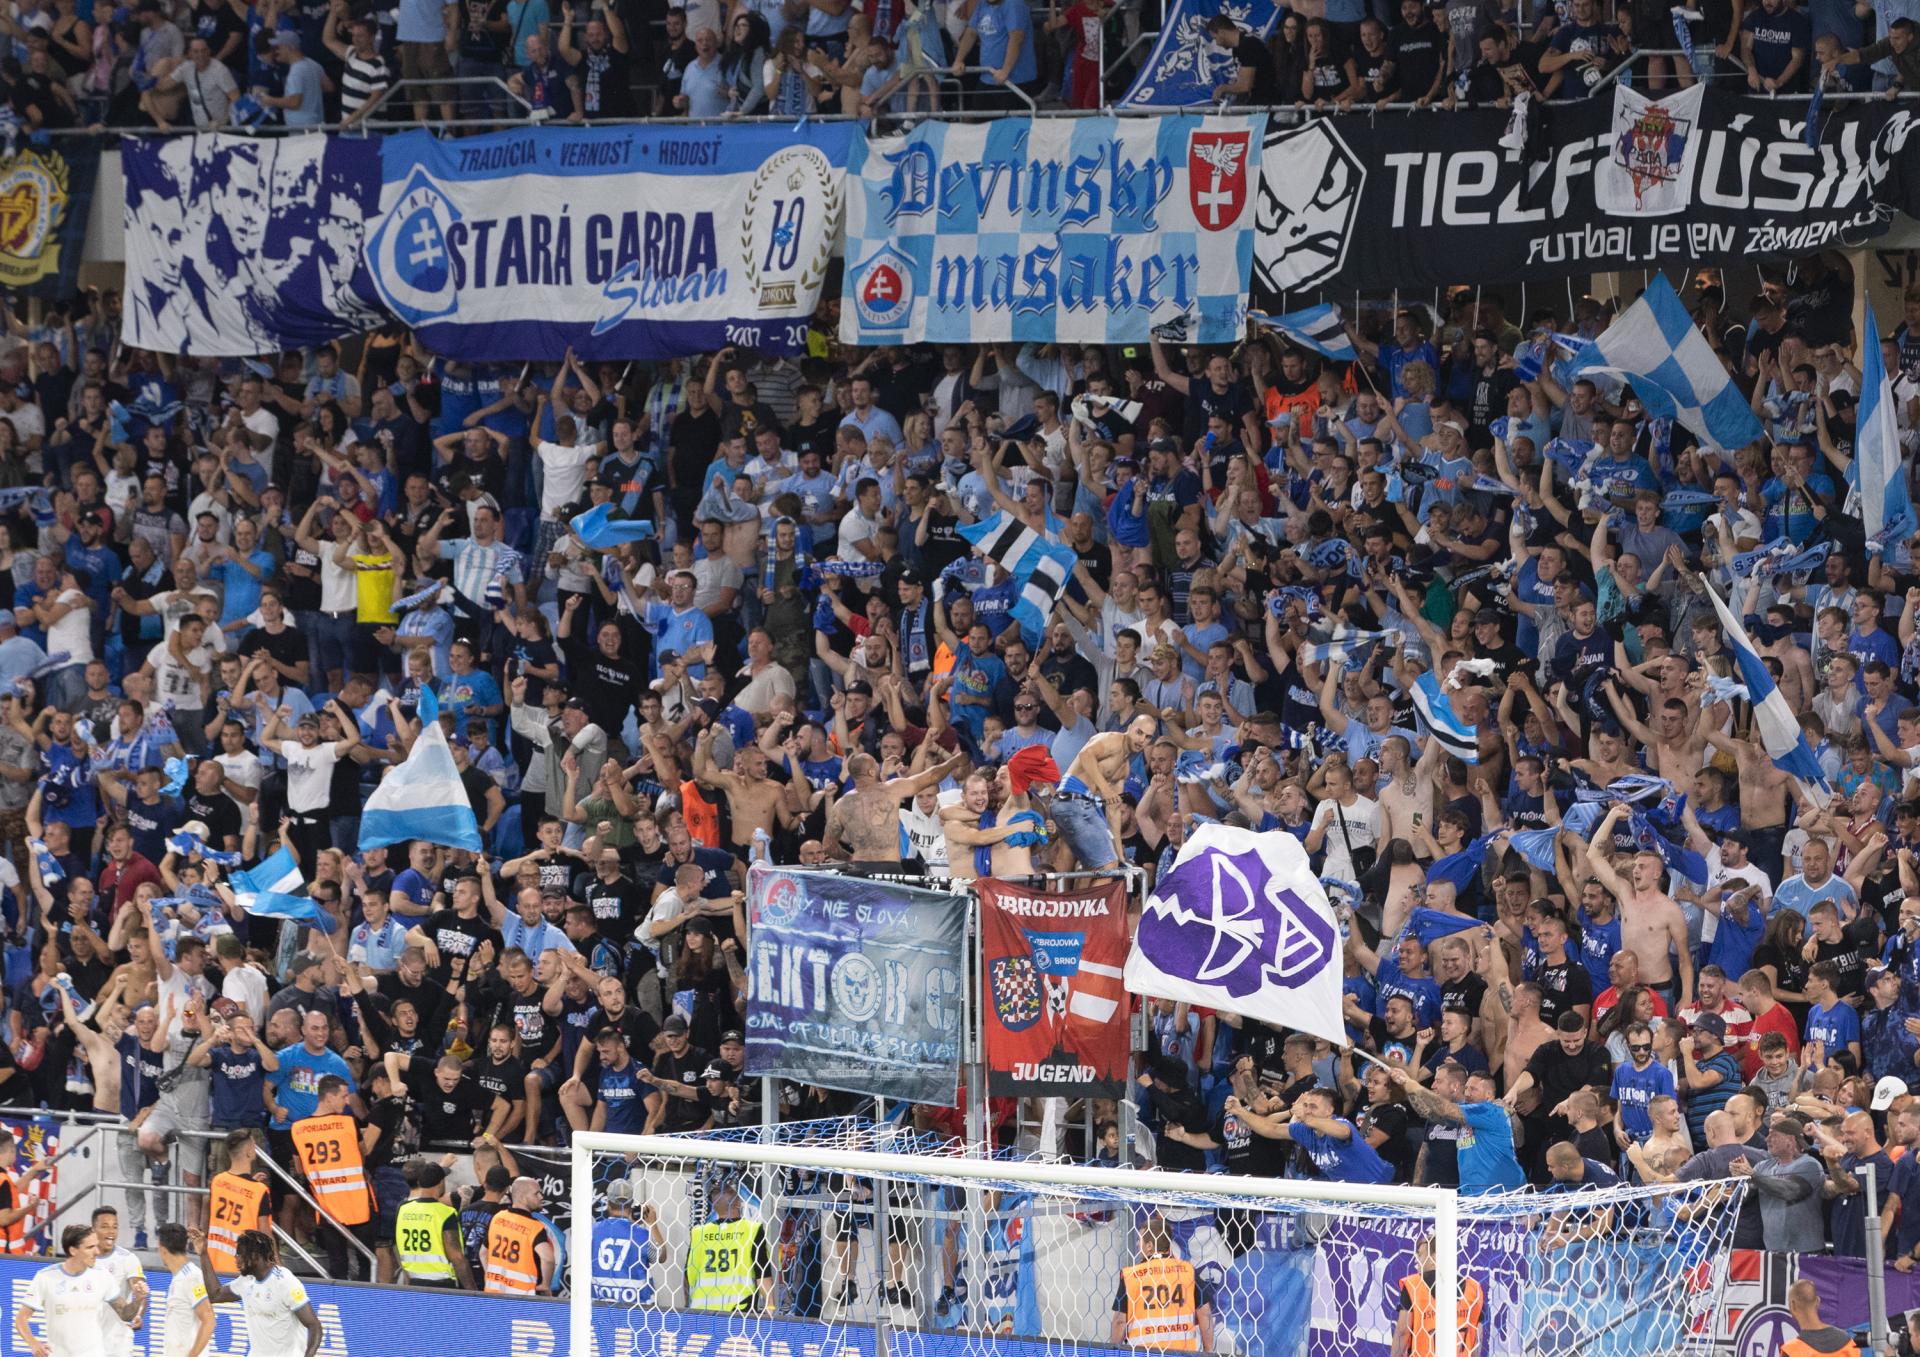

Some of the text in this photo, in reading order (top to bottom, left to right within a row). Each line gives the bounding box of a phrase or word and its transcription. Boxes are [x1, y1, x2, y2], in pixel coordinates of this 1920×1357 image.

[459, 135, 722, 172] TRADÍCIA VERNOSŤ HRDOSŤ
[880, 128, 1175, 233] Devínsky
[446, 203, 718, 291] STARÁ GARDA
[762, 196, 805, 273] 10
[935, 230, 1201, 316] masaker
[1053, 956, 1077, 966] BRNO
[1011, 1062, 1097, 1084] JUGEND
[305, 1140, 342, 1166] 293
[215, 1197, 244, 1226] 275
[402, 1228, 432, 1253] 288
[491, 1234, 521, 1264] 228
[703, 1231, 745, 1242] SECURITY
[598, 1237, 632, 1272] 67
[705, 1248, 739, 1273] 281
[1142, 1283, 1185, 1311] 204
[1145, 1323, 1189, 1335] STEWARD
